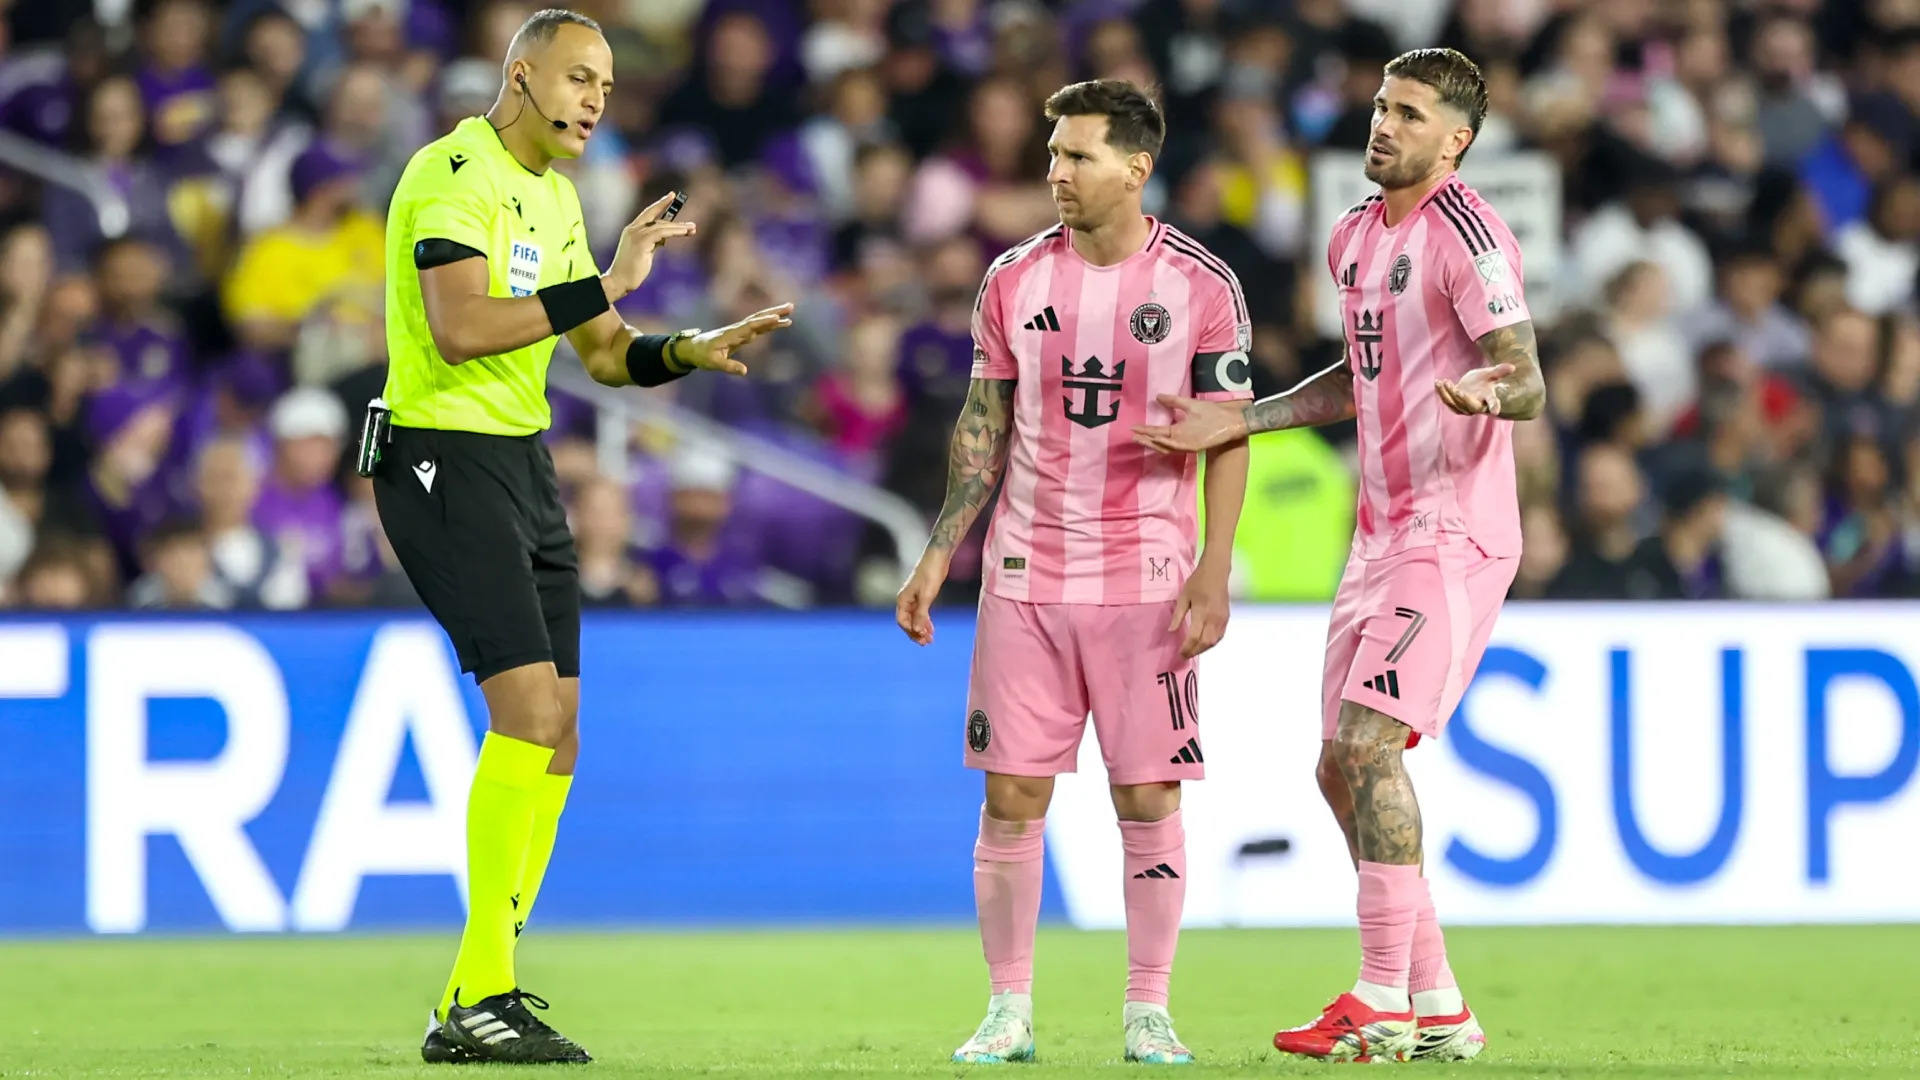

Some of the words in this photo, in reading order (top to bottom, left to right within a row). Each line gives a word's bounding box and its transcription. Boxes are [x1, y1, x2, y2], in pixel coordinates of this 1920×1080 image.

[510, 267, 537, 281] REFEREE
[513, 244, 538, 264] FIFA
[1504, 294, 1519, 311] tv
[1215, 351, 1252, 392] C
[1384, 607, 1427, 664] 7
[1157, 669, 1198, 730] 10
[1444, 646, 1920, 887] SUP
